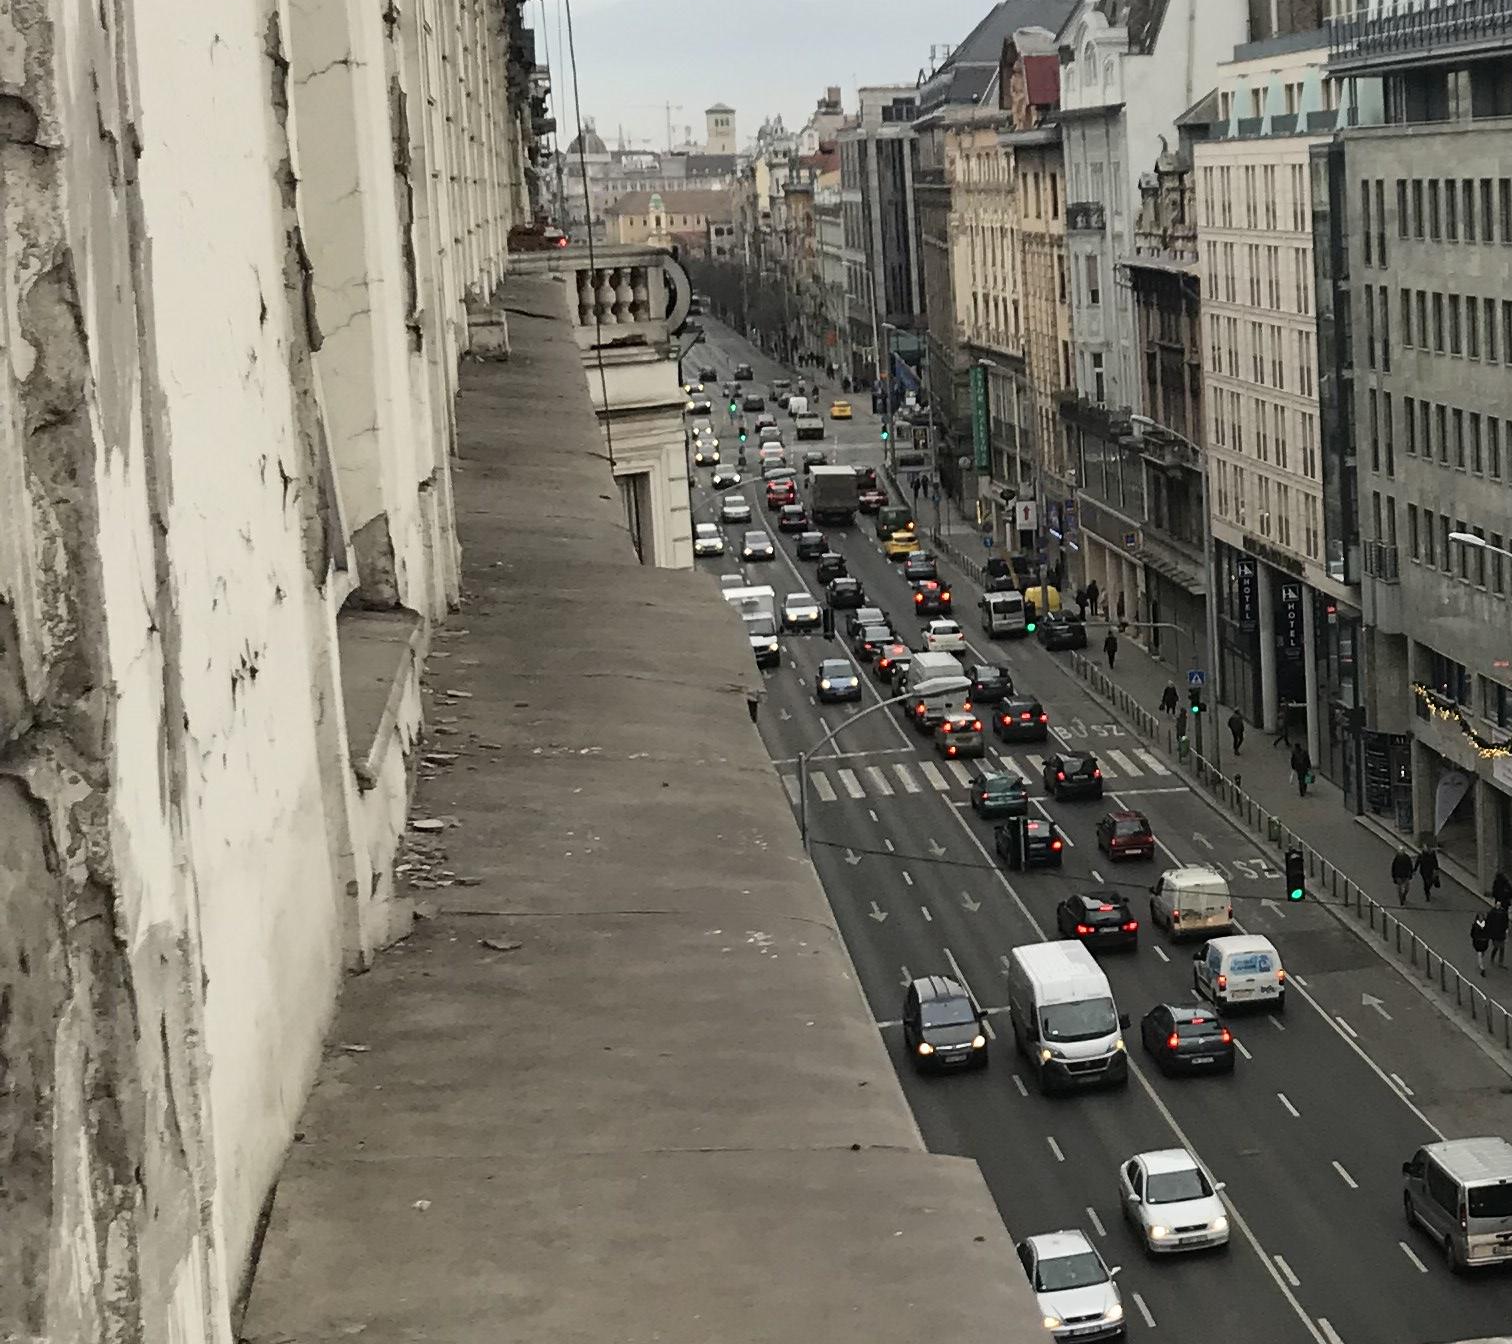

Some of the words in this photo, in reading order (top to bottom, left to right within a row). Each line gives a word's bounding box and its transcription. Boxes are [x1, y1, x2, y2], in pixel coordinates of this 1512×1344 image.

[1243, 578, 1251, 620] HOTEL
[1287, 602, 1296, 646] HOTEL
[1053, 724, 1126, 740] BUSZ
